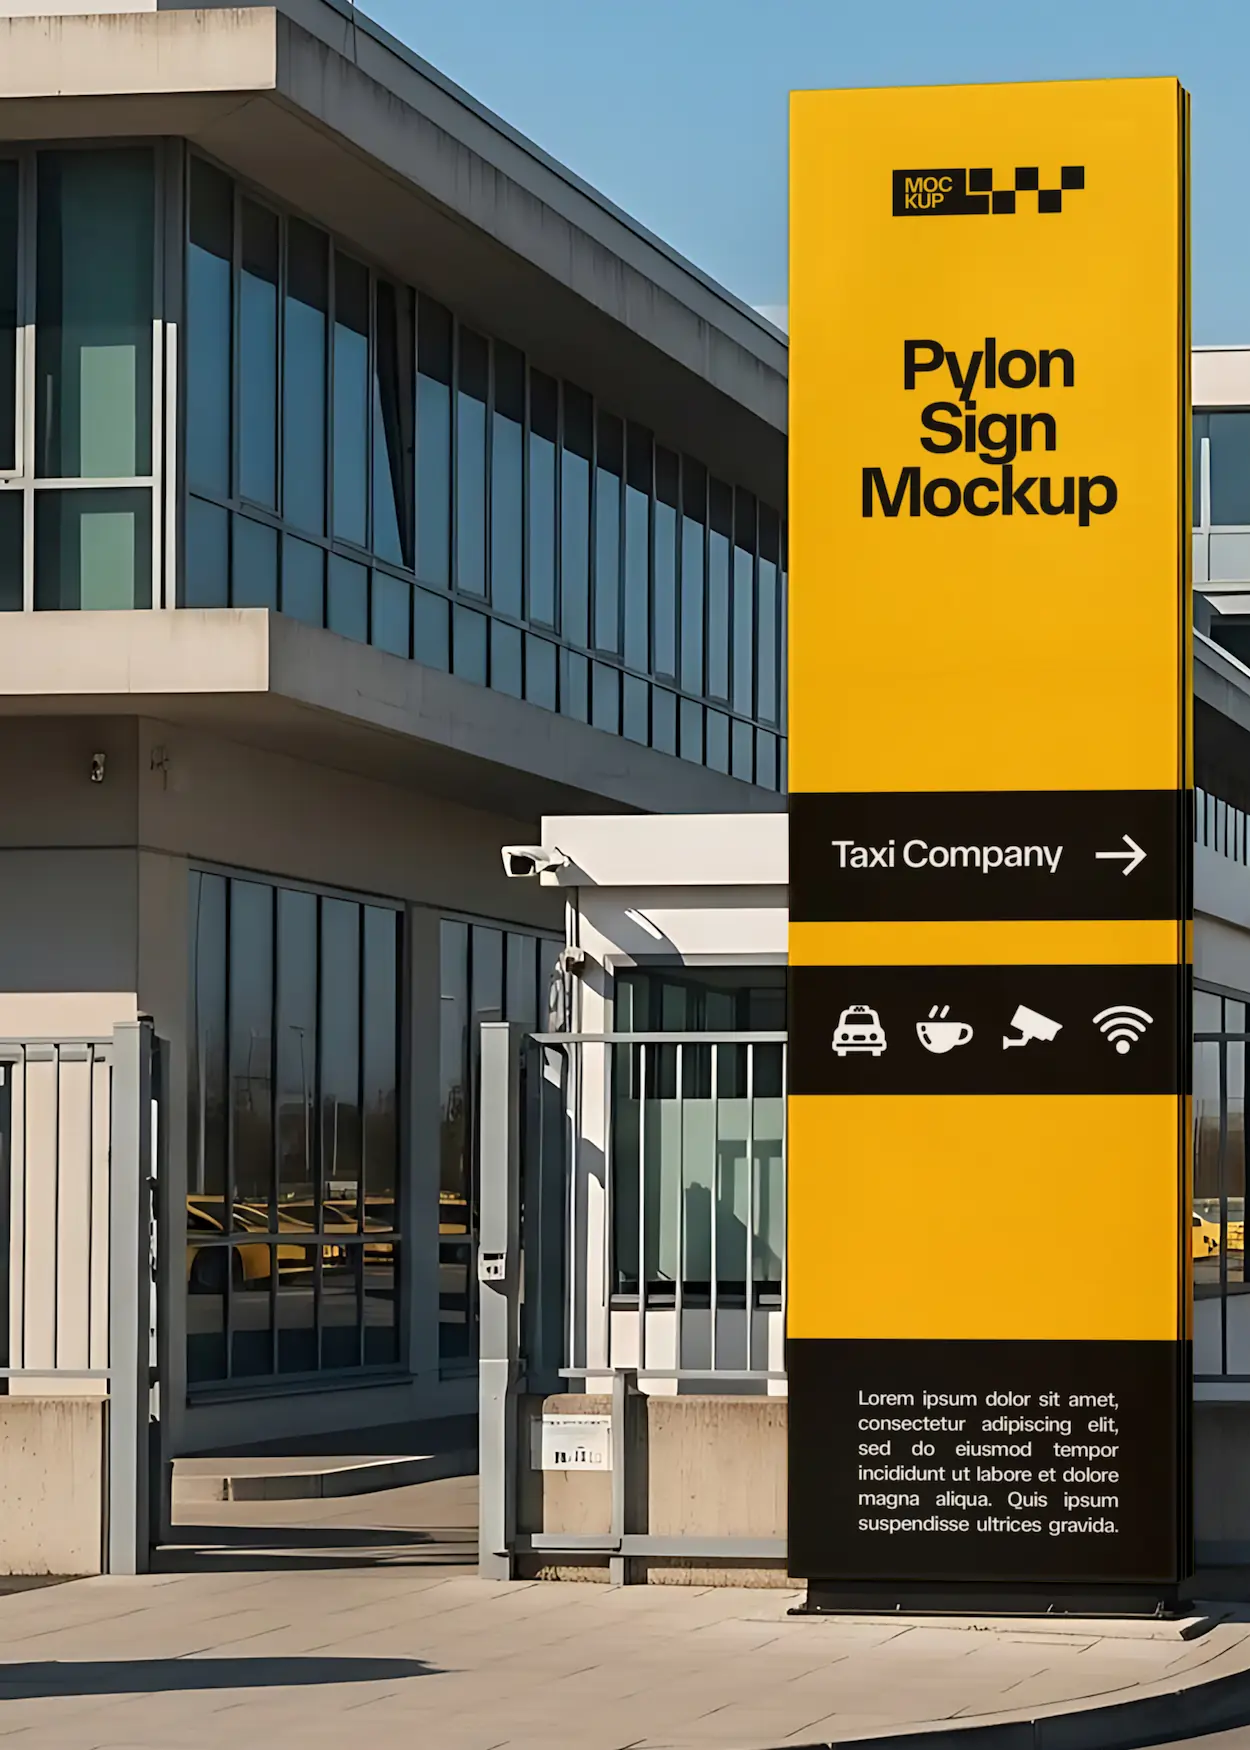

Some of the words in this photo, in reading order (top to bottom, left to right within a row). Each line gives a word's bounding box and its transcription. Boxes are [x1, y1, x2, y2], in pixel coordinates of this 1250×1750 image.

[905, 176, 953, 194] MOC
[904, 193, 945, 209] KUP
[904, 337, 1075, 402] Pylon
[920, 401, 1057, 465] Sign
[861, 464, 1118, 527] Mockup
[831, 839, 895, 868] Taxi
[902, 839, 1064, 874] Company
[858, 1390, 915, 1405] Lorem
[922, 1390, 978, 1409] ipsum
[985, 1391, 1032, 1406] dolor
[1038, 1391, 1061, 1407] sit
[1068, 1393, 1119, 1410] amet,
[857, 1417, 967, 1431] consectetur
[981, 1416, 1072, 1435] adipiscing
[1087, 1417, 1119, 1435] elit,
[858, 1440, 891, 1455] sed
[911, 1441, 936, 1456] do
[955, 1441, 1032, 1457] eiusmod
[1052, 1443, 1120, 1460] tempor
[858, 1465, 946, 1481] incididunt
[951, 1467, 971, 1481] ut
[976, 1466, 1033, 1482] labore
[1037, 1468, 1057, 1482] et
[1062, 1467, 1120, 1482] dolore
[858, 1494, 920, 1509] magna
[935, 1491, 993, 1510] aliqua.
[1007, 1491, 1048, 1509] Quis
[1063, 1492, 1119, 1511] ipsum
[858, 1516, 970, 1534] suspendisse
[976, 1516, 1042, 1532] ultrices
[1048, 1517, 1119, 1536] gravida.
